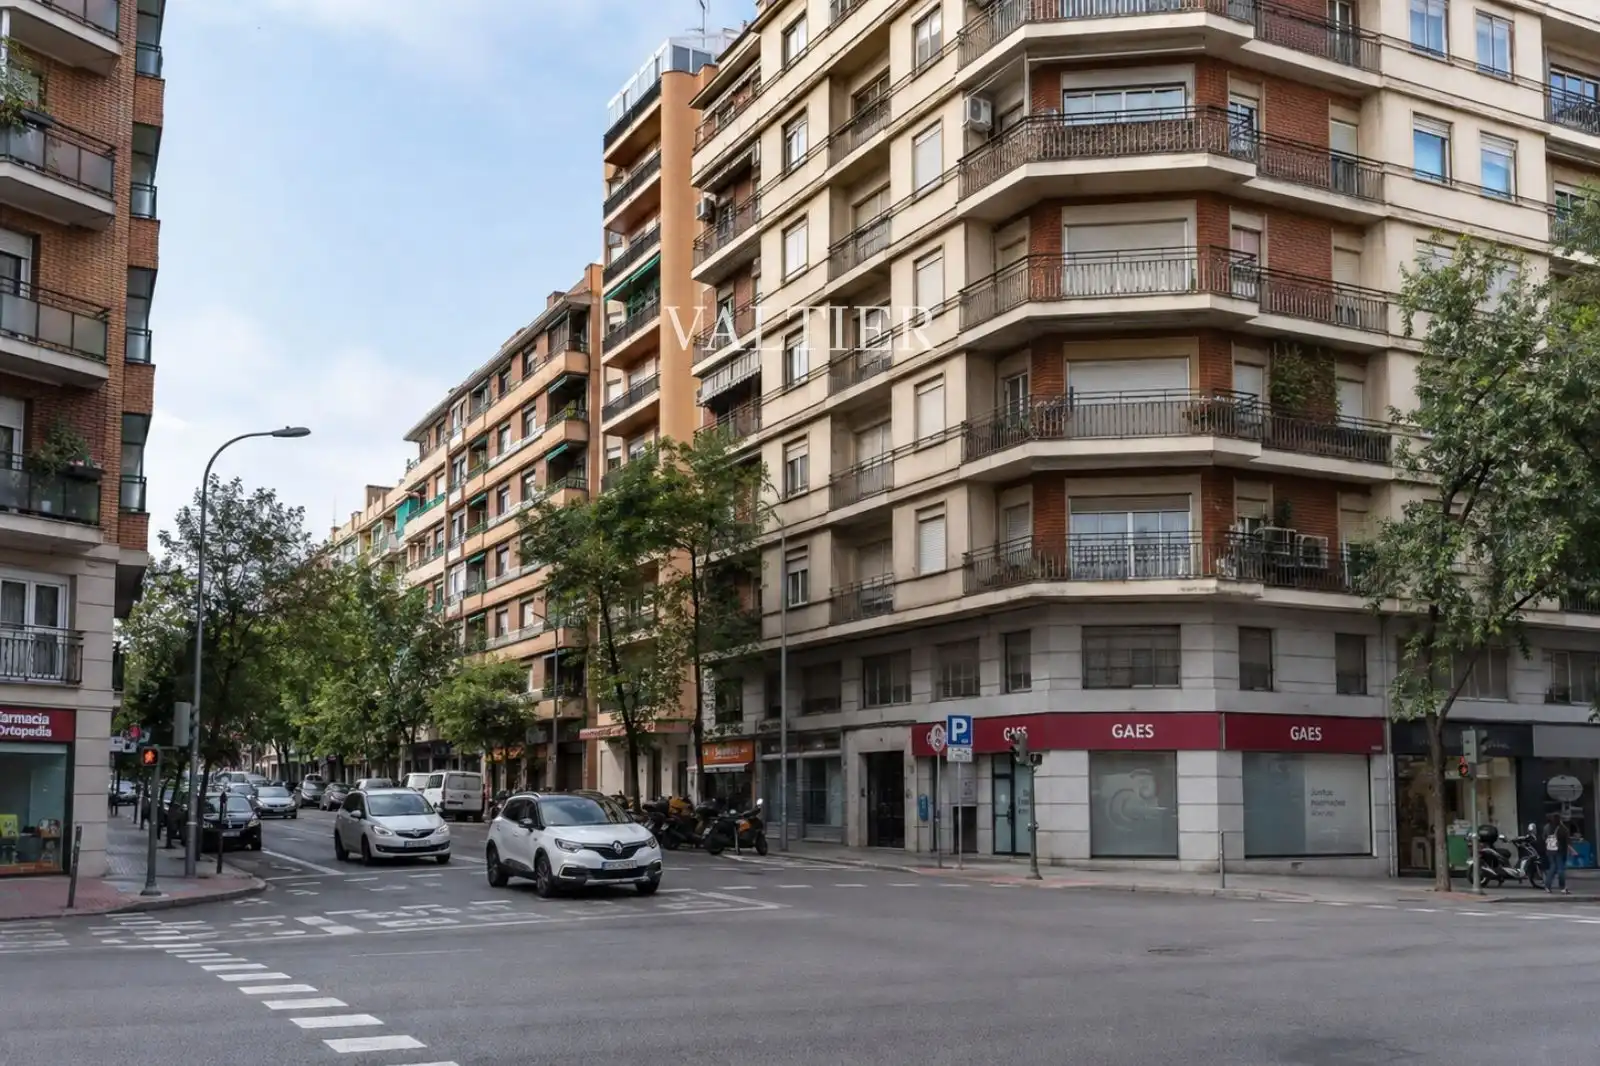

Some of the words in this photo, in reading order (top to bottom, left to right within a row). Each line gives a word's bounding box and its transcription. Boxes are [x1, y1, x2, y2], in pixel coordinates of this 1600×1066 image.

[952, 718, 968, 741] P
[1111, 723, 1155, 739] GAES
[1290, 726, 1322, 741] GAES
